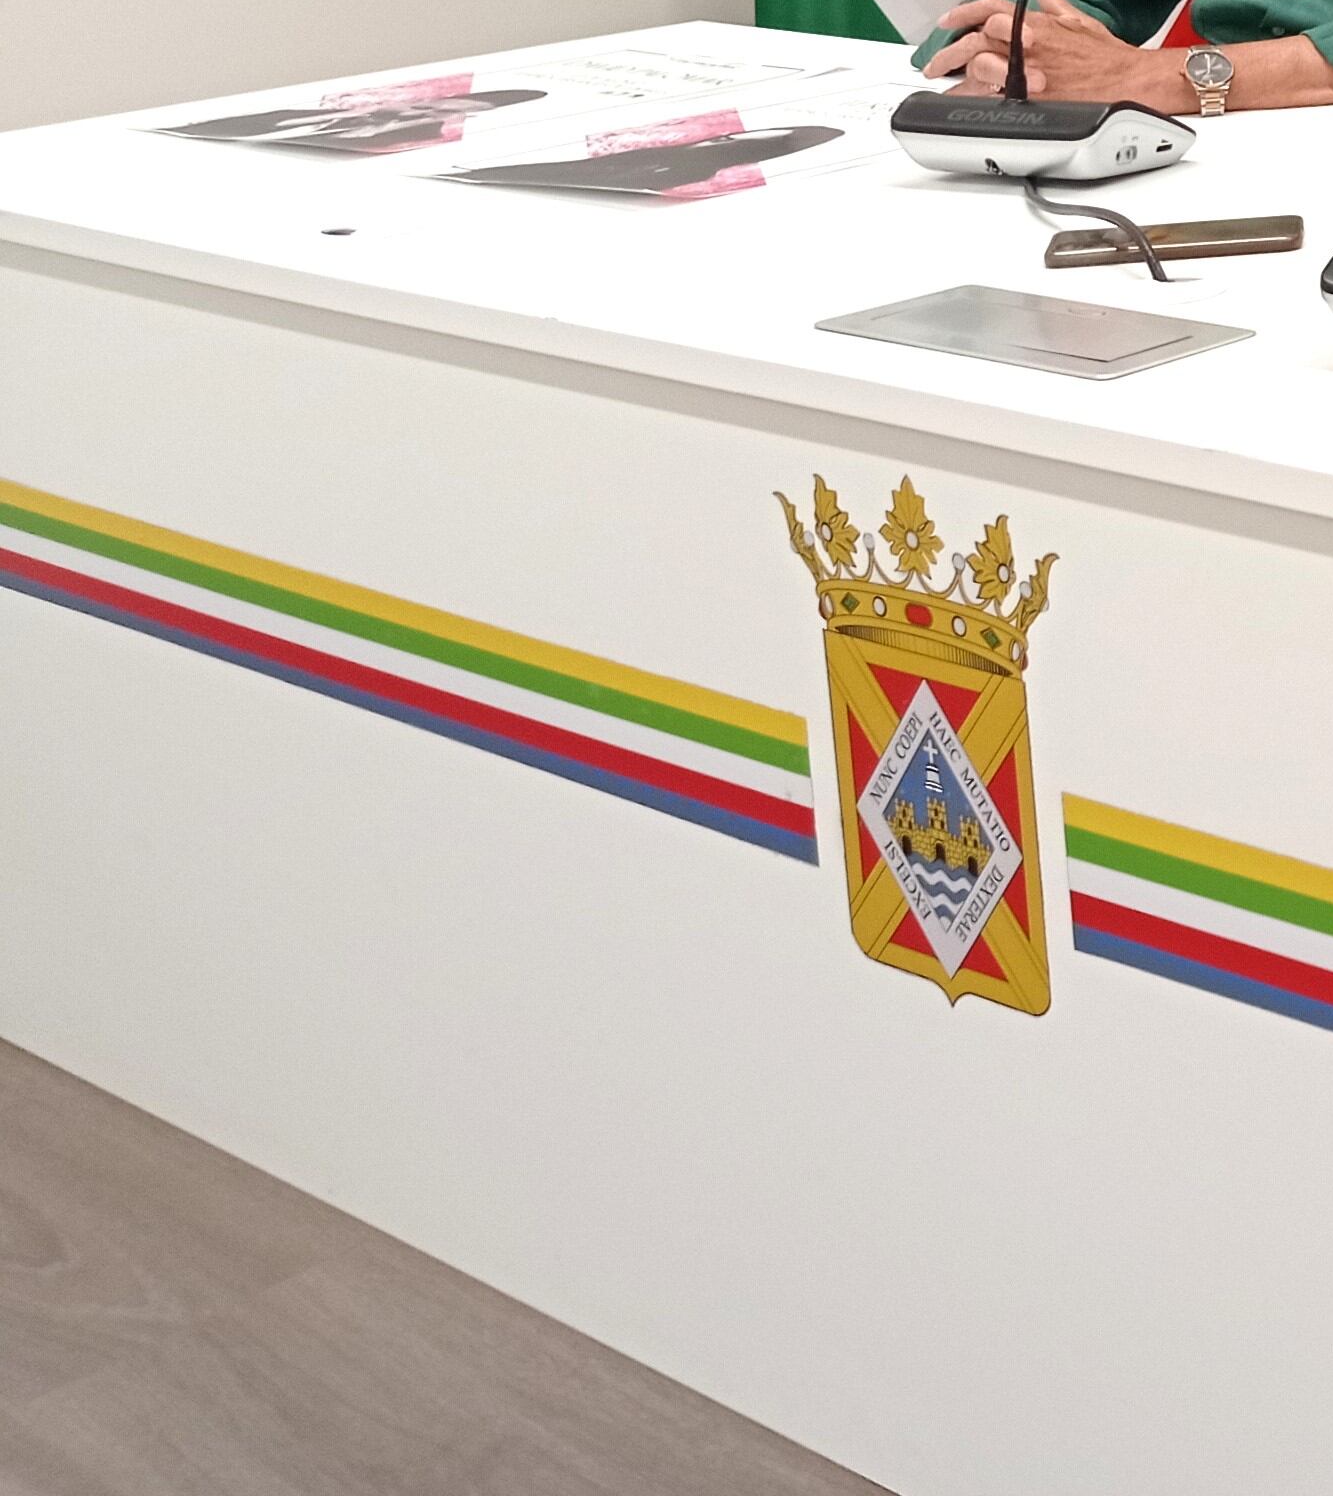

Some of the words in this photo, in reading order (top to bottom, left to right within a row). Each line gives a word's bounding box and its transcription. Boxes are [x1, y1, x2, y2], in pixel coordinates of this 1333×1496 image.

[947, 108, 1046, 126] GONSIN
[929, 711, 962, 762] HAEC
[961, 767, 1010, 852] MUTATIO
